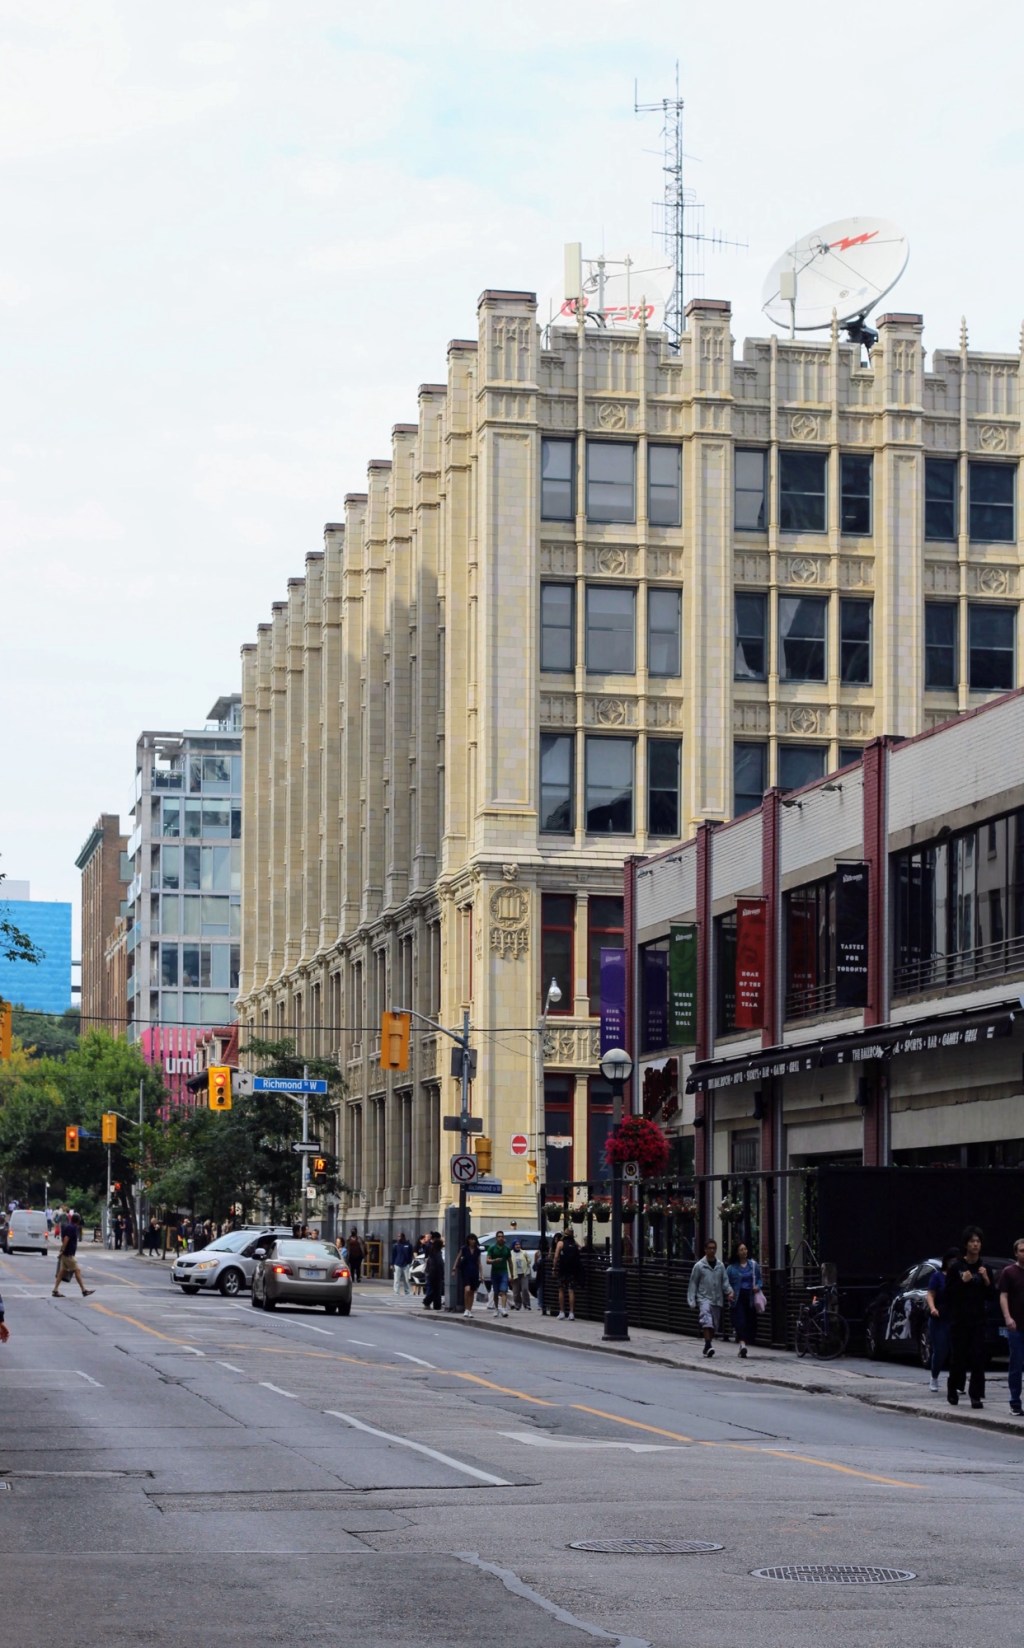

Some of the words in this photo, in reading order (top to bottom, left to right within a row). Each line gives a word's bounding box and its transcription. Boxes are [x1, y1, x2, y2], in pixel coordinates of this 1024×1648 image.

[840, 943, 865, 951] TASTES
[837, 965, 868, 973] TORONTO
[904, 1037, 923, 1053] SPORTS
[927, 1035, 938, 1049] BAR
[942, 1031, 960, 1047] GAMES
[263, 1079, 303, 1089] Richmond
[310, 1081, 317, 1090] W
